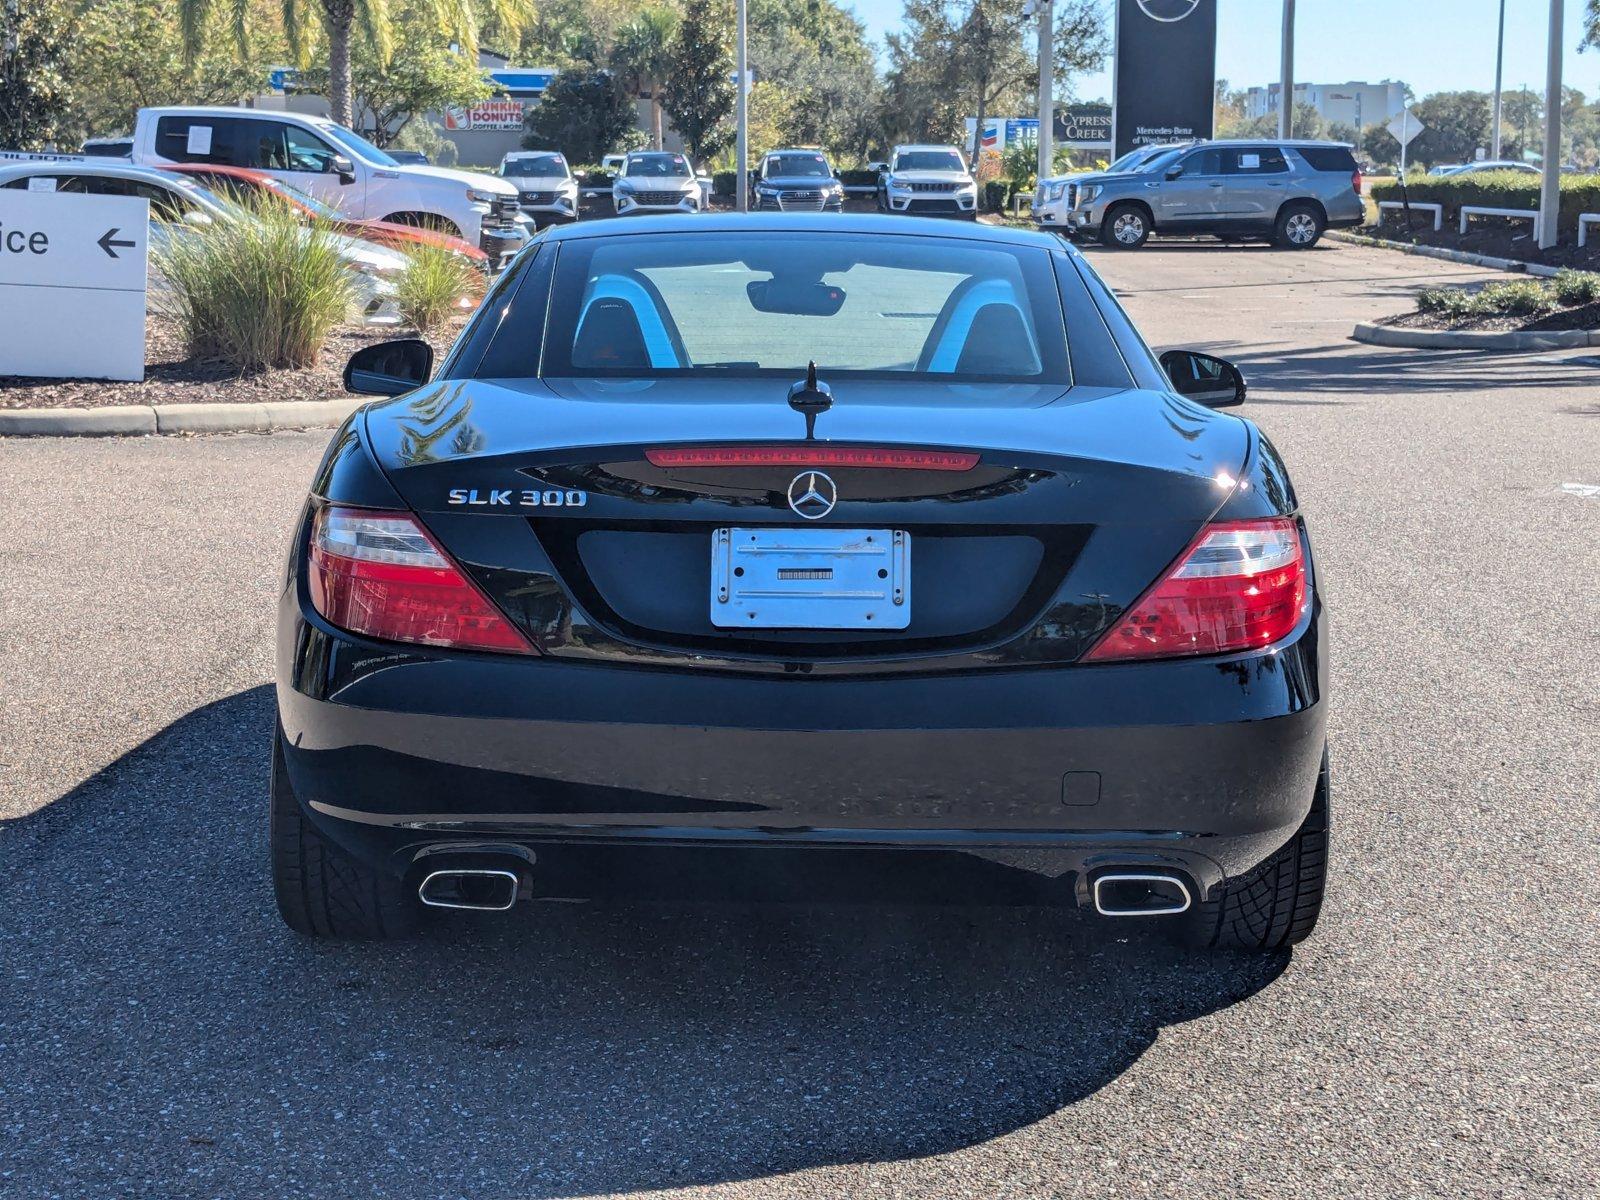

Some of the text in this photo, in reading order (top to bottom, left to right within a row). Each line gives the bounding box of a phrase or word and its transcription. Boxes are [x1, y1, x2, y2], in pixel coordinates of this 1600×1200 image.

[473, 112, 522, 122] DONUTS
[1060, 112, 1112, 126] CYPRESS
[1065, 125, 1106, 139] CREEK
[1136, 126, 1193, 135] Mercedes-Benz
[1132, 136, 1141, 144] of
[447, 489, 587, 507] SLK 300
